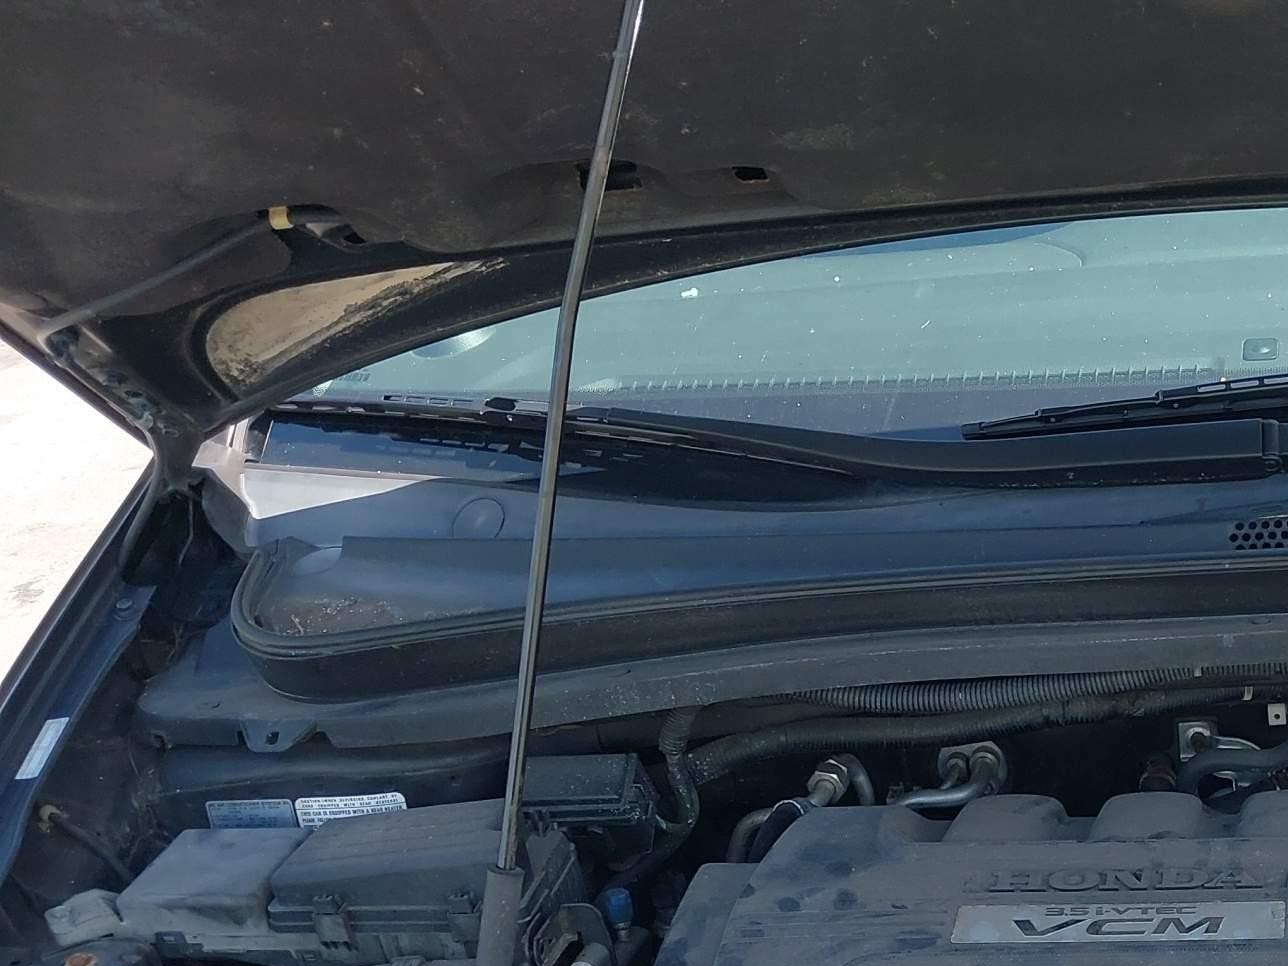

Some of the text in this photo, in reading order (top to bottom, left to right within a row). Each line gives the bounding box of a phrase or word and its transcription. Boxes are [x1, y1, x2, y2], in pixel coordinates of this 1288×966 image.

[987, 867, 1264, 893] HONDA
[1044, 906, 1091, 917] 3.5
[1012, 916, 1225, 936] VCM
